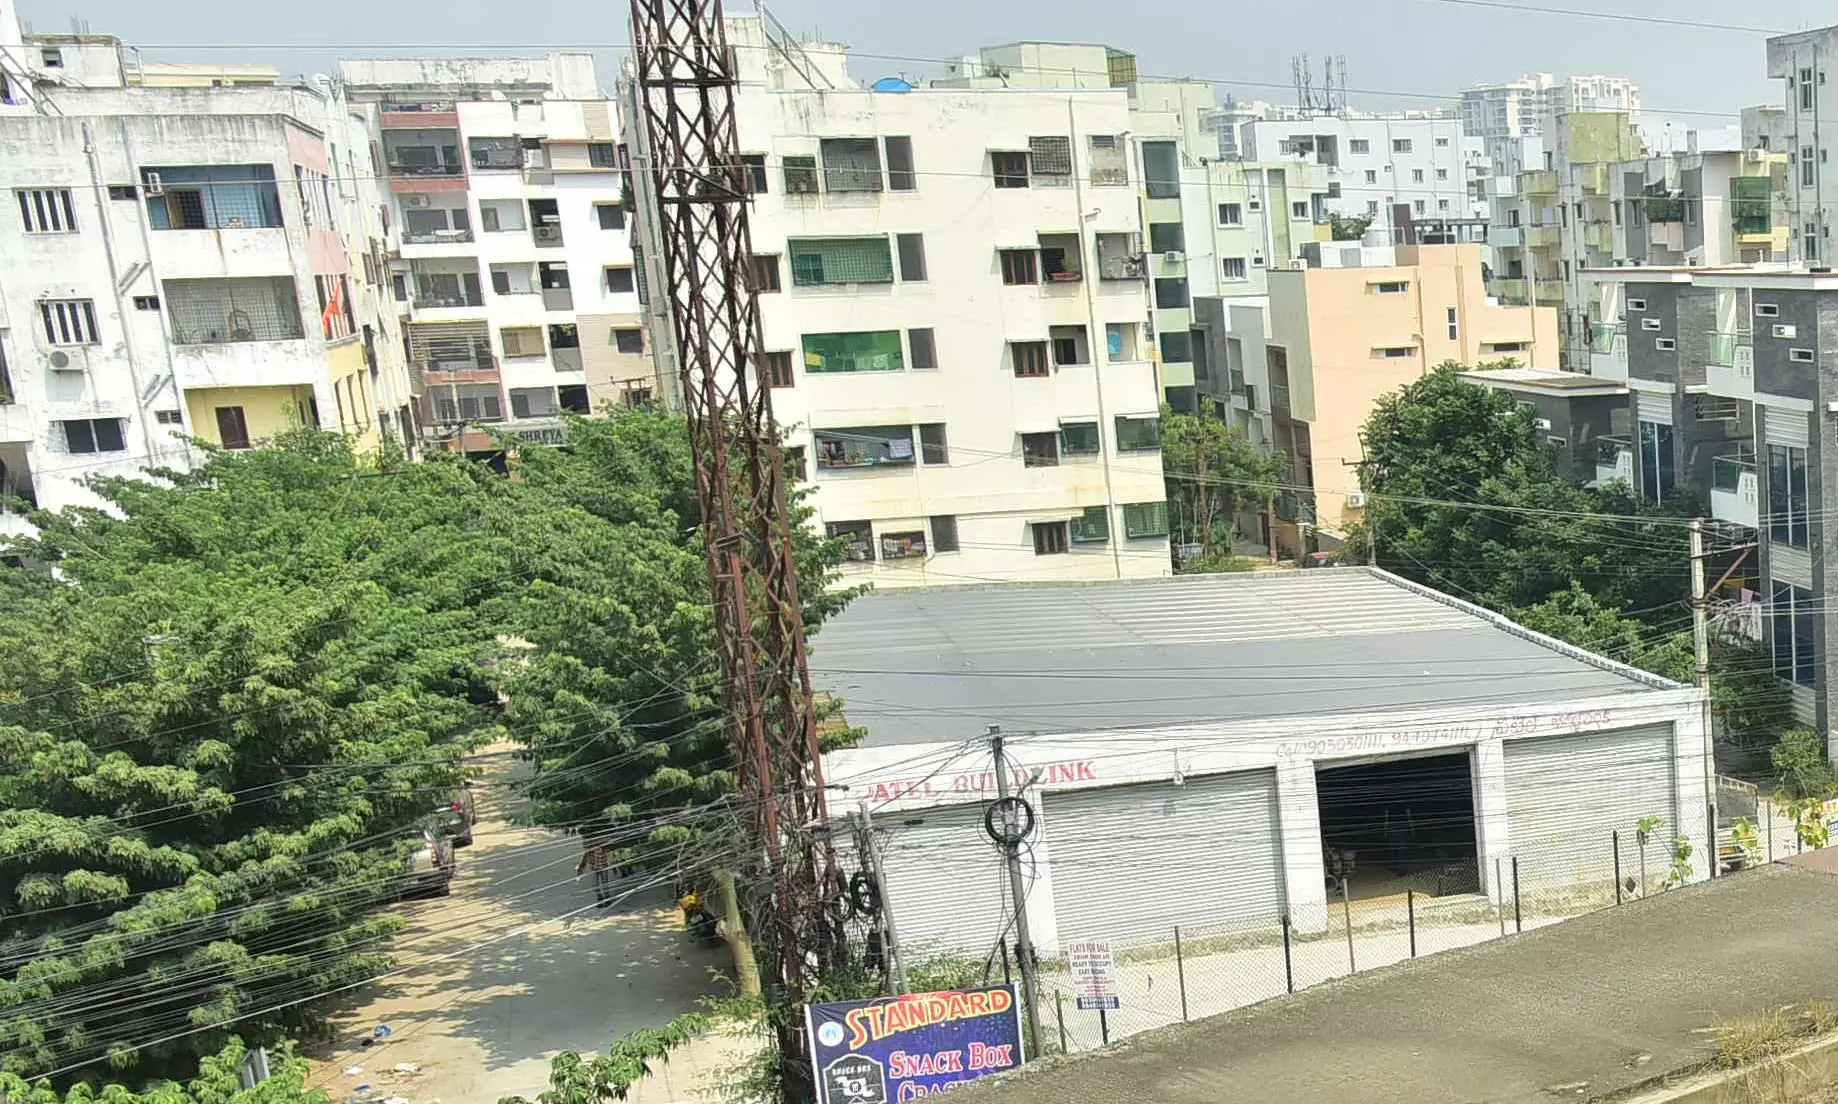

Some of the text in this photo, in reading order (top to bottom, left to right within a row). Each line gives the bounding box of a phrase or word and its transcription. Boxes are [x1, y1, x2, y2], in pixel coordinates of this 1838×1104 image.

[844, 990, 1012, 1050] STANDARD
[889, 1042, 1014, 1080] SNACK BOX
